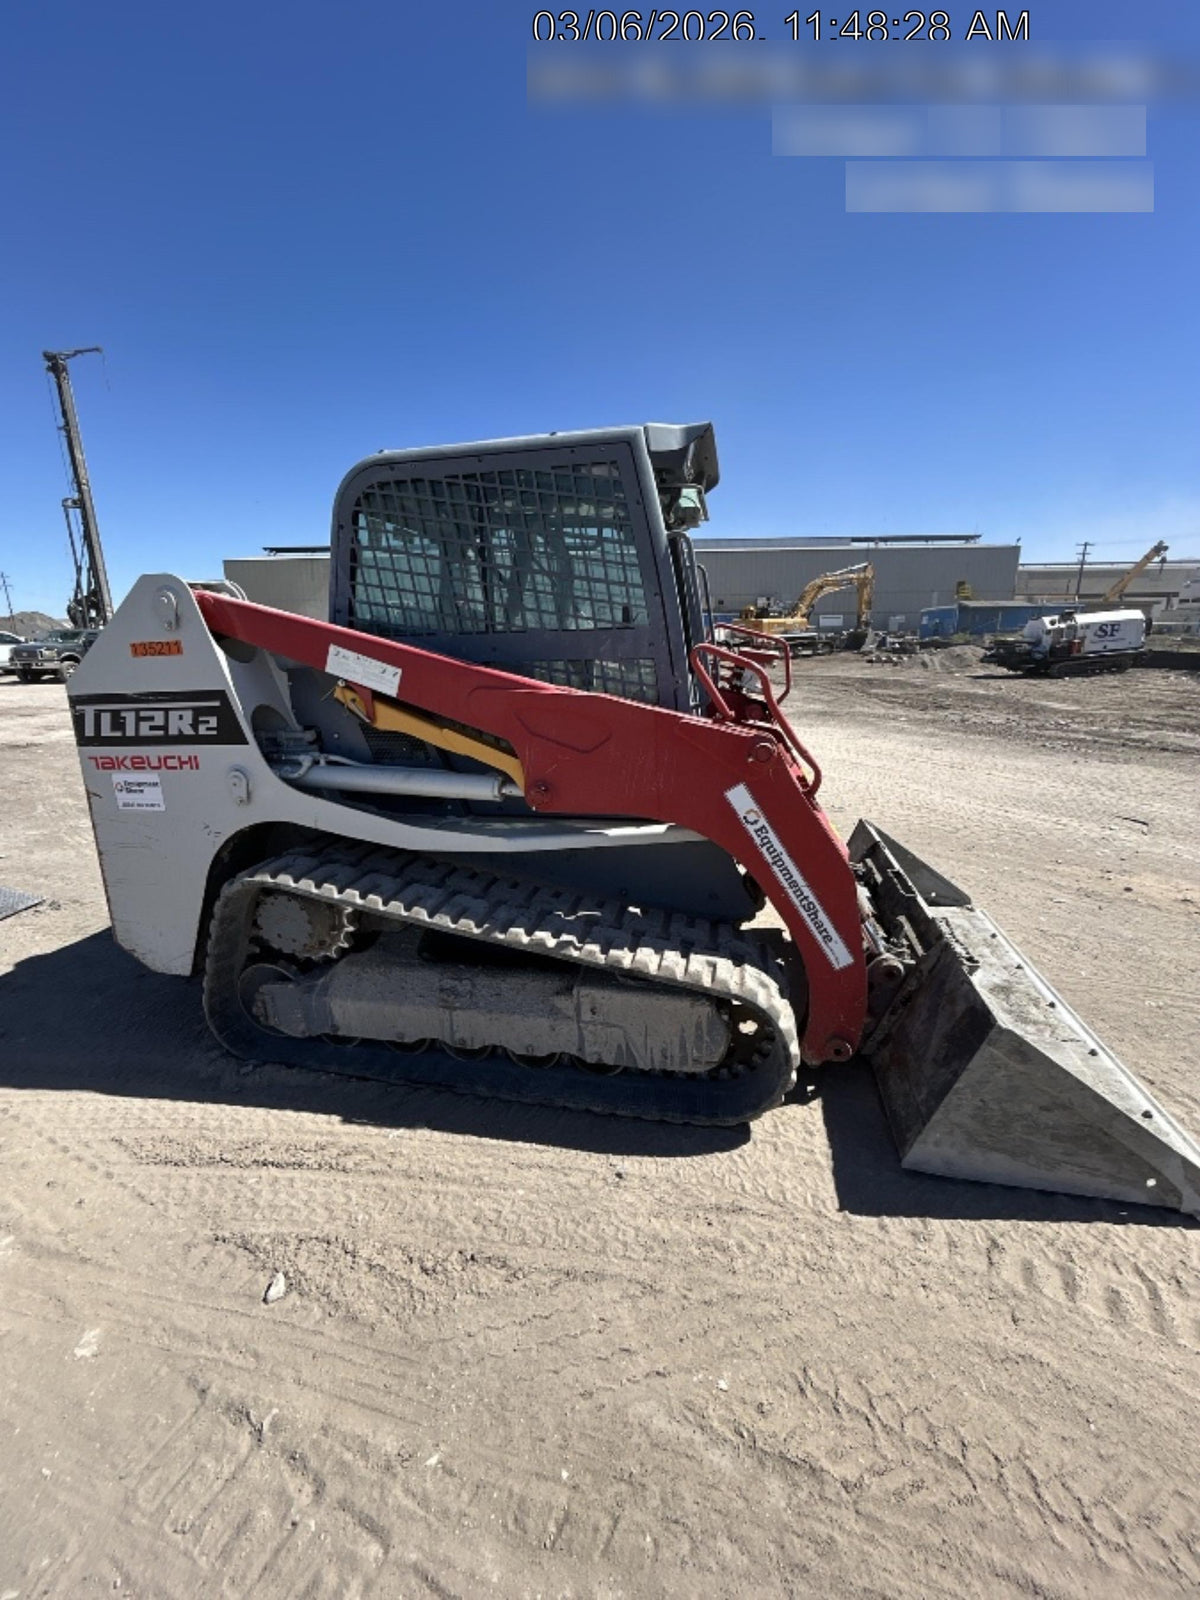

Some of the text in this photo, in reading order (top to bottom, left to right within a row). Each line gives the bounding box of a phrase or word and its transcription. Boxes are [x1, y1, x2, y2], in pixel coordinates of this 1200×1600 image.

[1093, 623, 1121, 638] SF
[130, 640, 181, 657] 135211
[76, 700, 221, 737] TL12R2
[88, 755, 200, 770] TAKEUCHI
[754, 824, 834, 945] EquipmentShare
